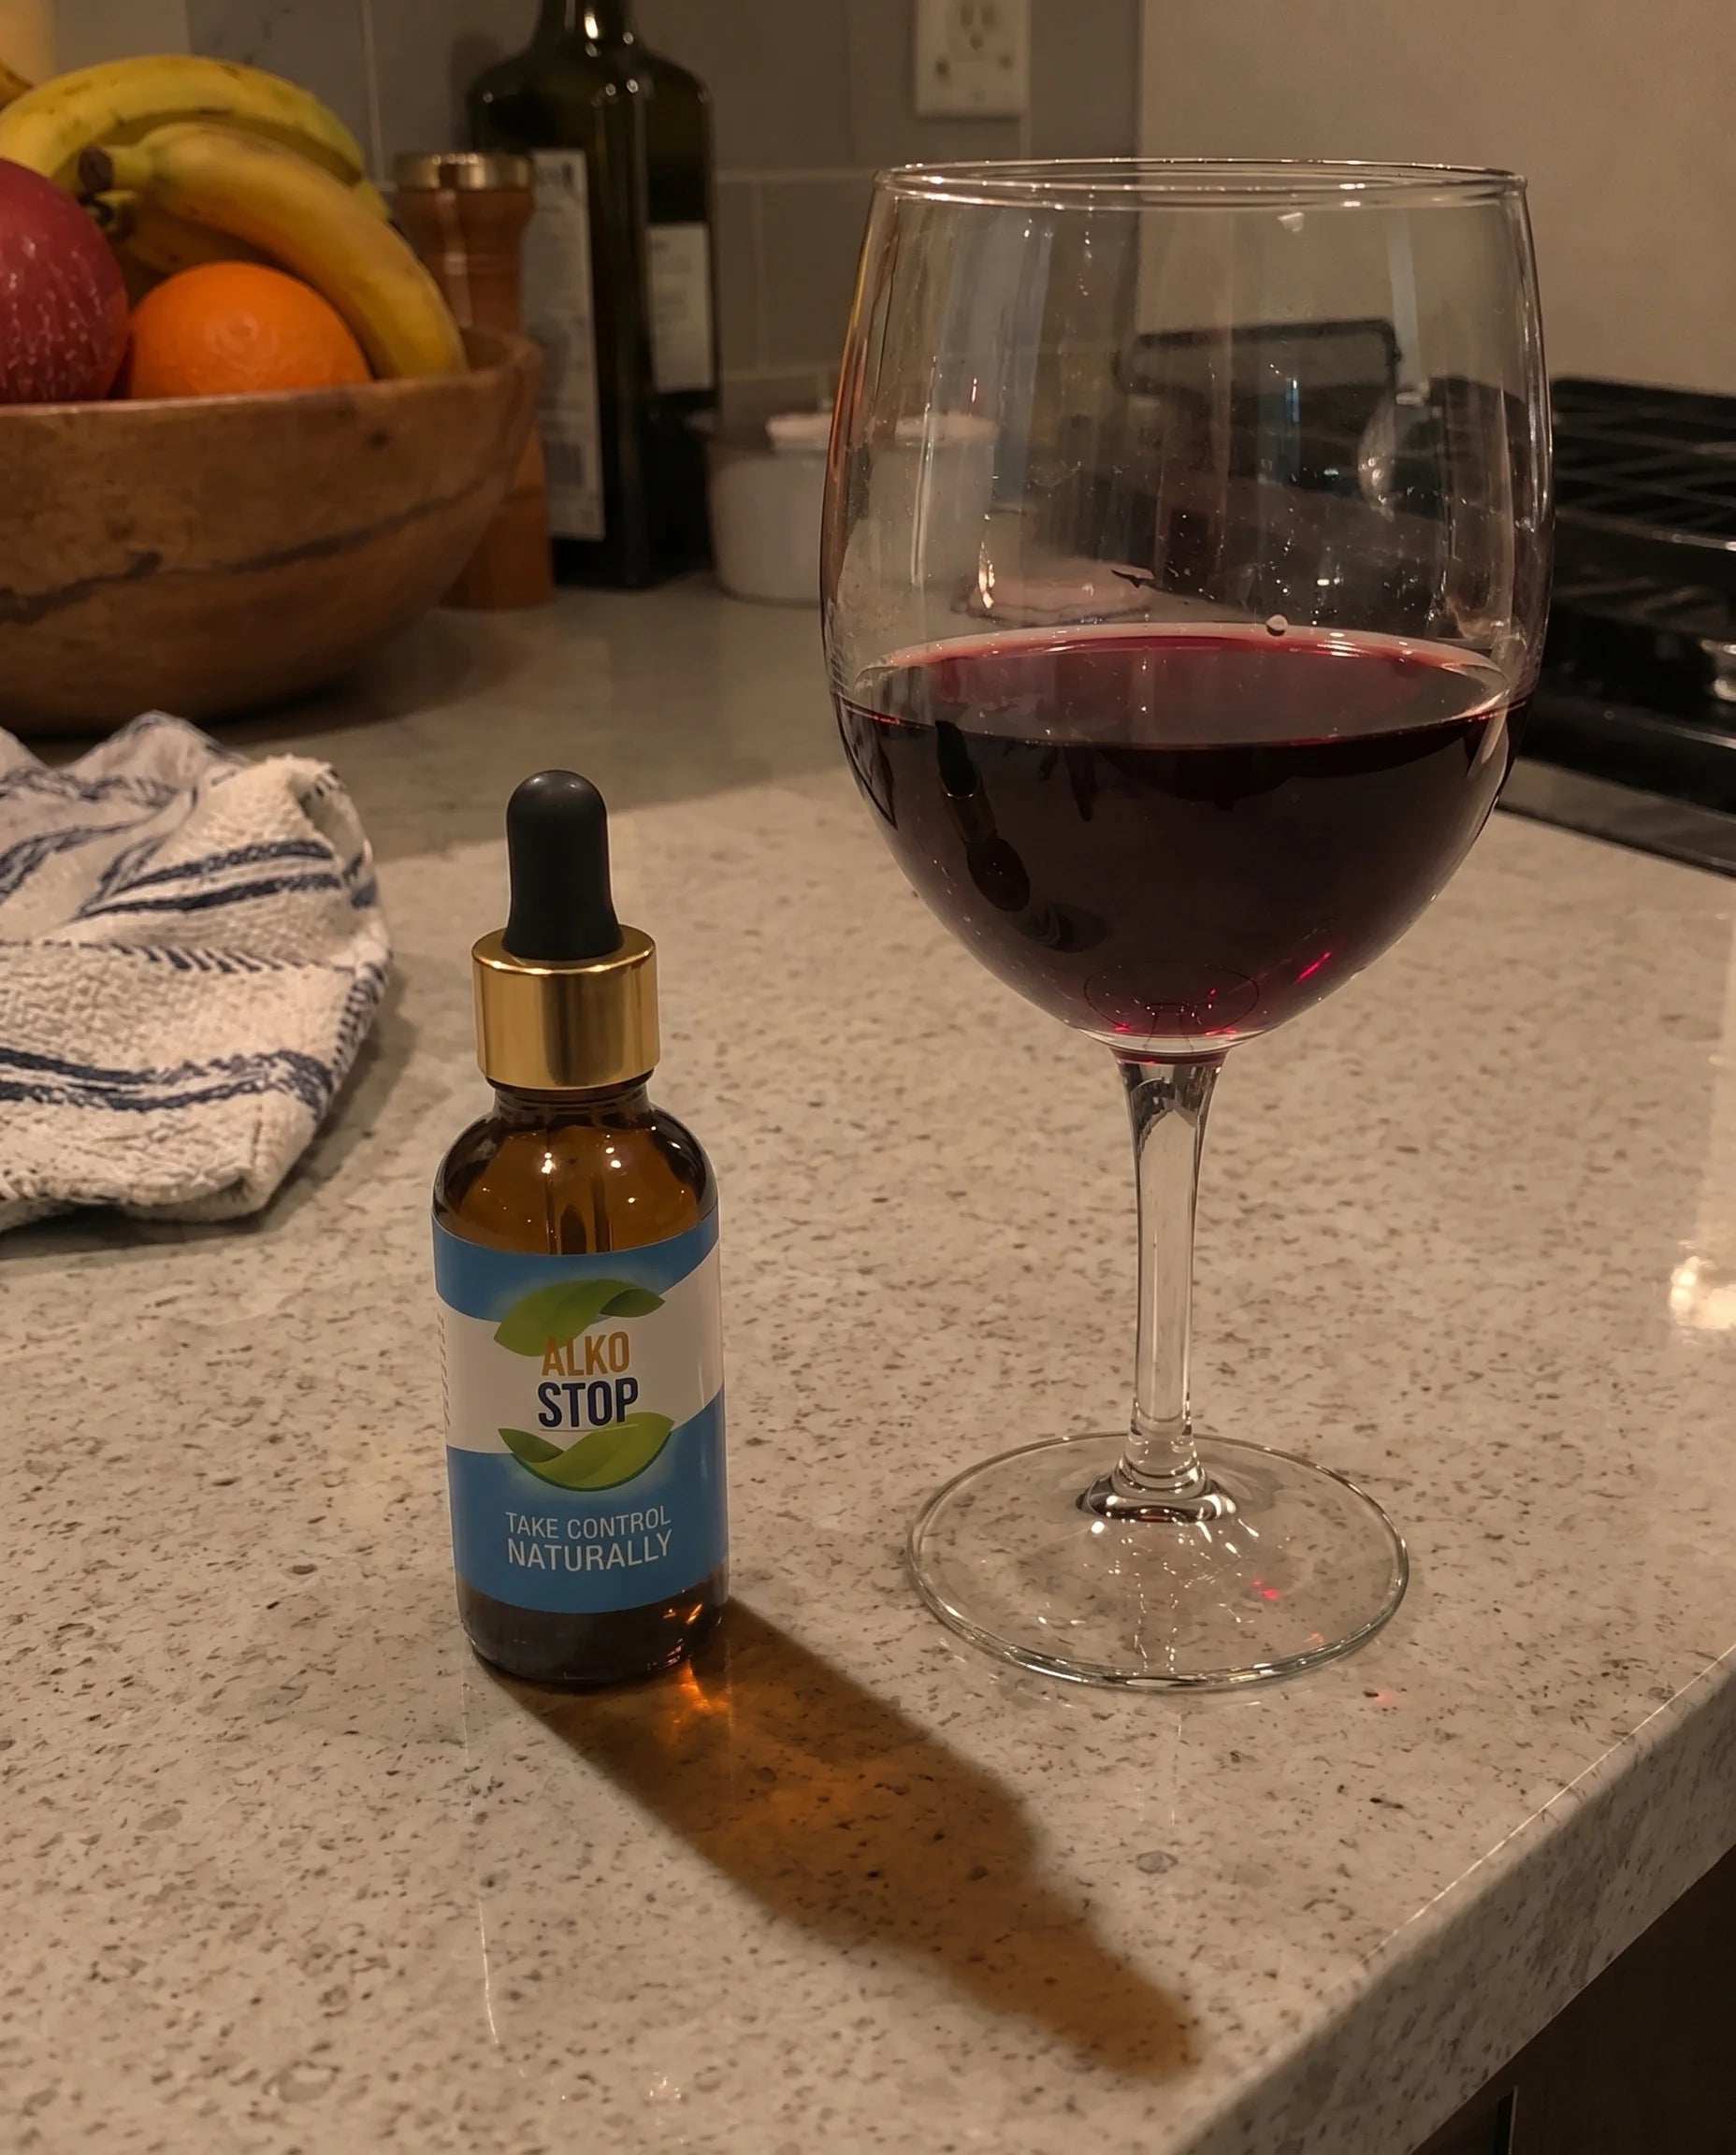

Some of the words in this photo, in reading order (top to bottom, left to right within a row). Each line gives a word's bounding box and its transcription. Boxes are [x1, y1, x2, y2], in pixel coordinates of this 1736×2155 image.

[542, 1331, 630, 1377] ALKO
[538, 1378, 639, 1427] STOP
[505, 1511, 558, 1540] TAKE
[567, 1505, 672, 1540] CONTROL
[507, 1529, 673, 1572] NATURALLY
